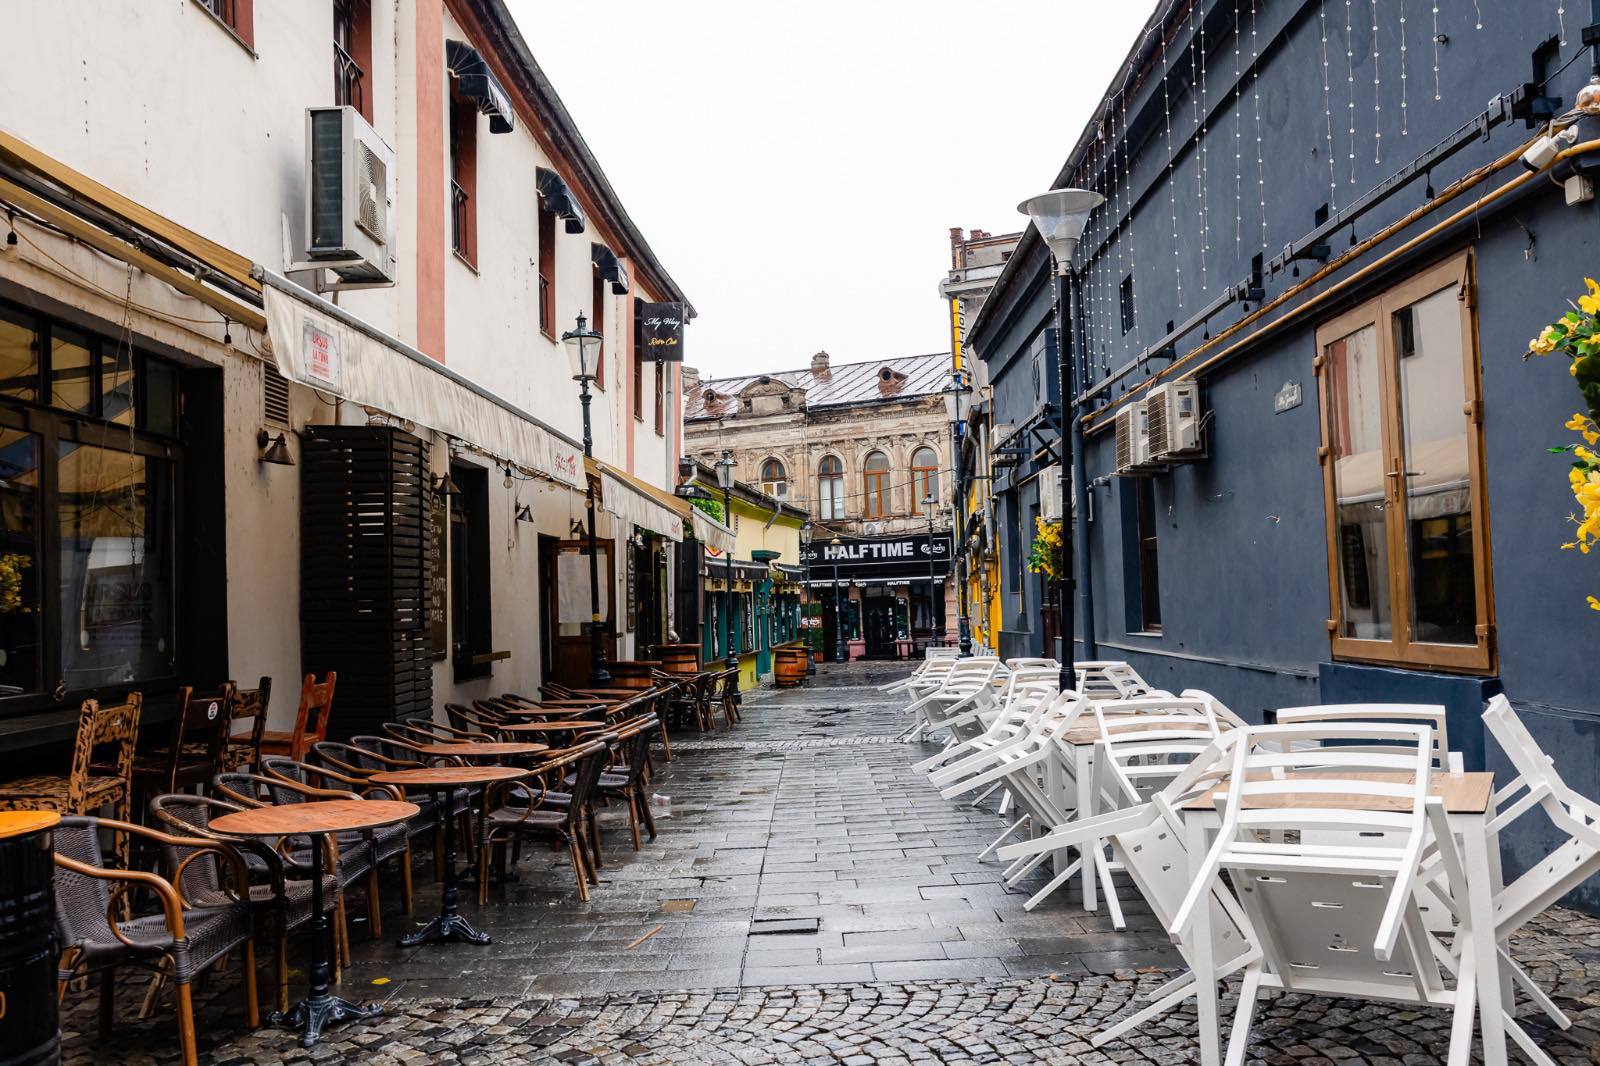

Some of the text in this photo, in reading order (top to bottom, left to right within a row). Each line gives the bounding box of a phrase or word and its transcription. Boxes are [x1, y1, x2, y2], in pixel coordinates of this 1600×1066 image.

[643, 317, 680, 330] My Way
[958, 301, 967, 371] HOTEL
[824, 541, 914, 560] HALFTIME
